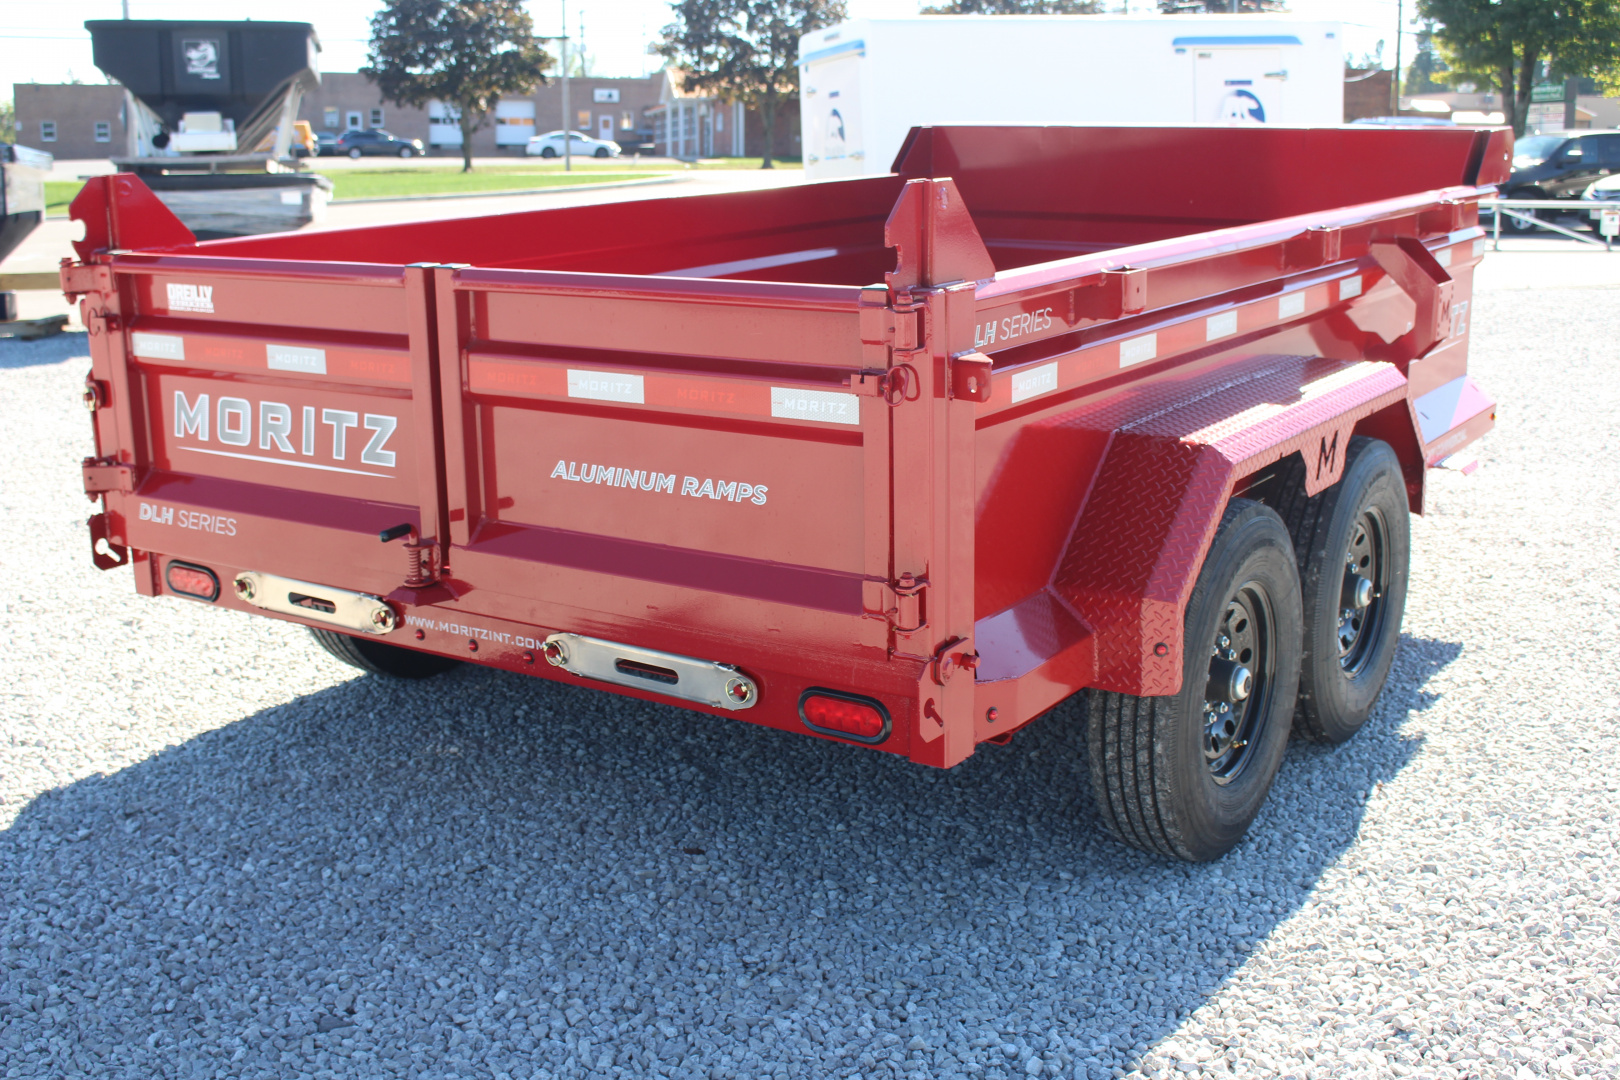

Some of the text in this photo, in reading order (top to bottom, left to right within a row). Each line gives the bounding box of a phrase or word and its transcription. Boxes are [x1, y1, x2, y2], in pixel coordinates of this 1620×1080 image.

[974, 307, 1053, 348] LH SERIES
[138, 339, 177, 353] MORITZ
[204, 346, 244, 360] MORITZ
[275, 352, 317, 367] MORITZ
[350, 359, 395, 374] MORITZ
[487, 371, 537, 386] MORITZ
[578, 378, 633, 395] MORITZ
[1018, 371, 1051, 392] MORITZ
[676, 387, 737, 404] MORITZ
[784, 398, 847, 416] MORITZ
[174, 390, 398, 468] MORITZ
[1315, 429, 1339, 481] M
[550, 460, 768, 505] ALUMINUM RAMPS
[139, 502, 237, 536] DLH SERIES
[404, 614, 547, 650] WWW.MORITZINT.COM
